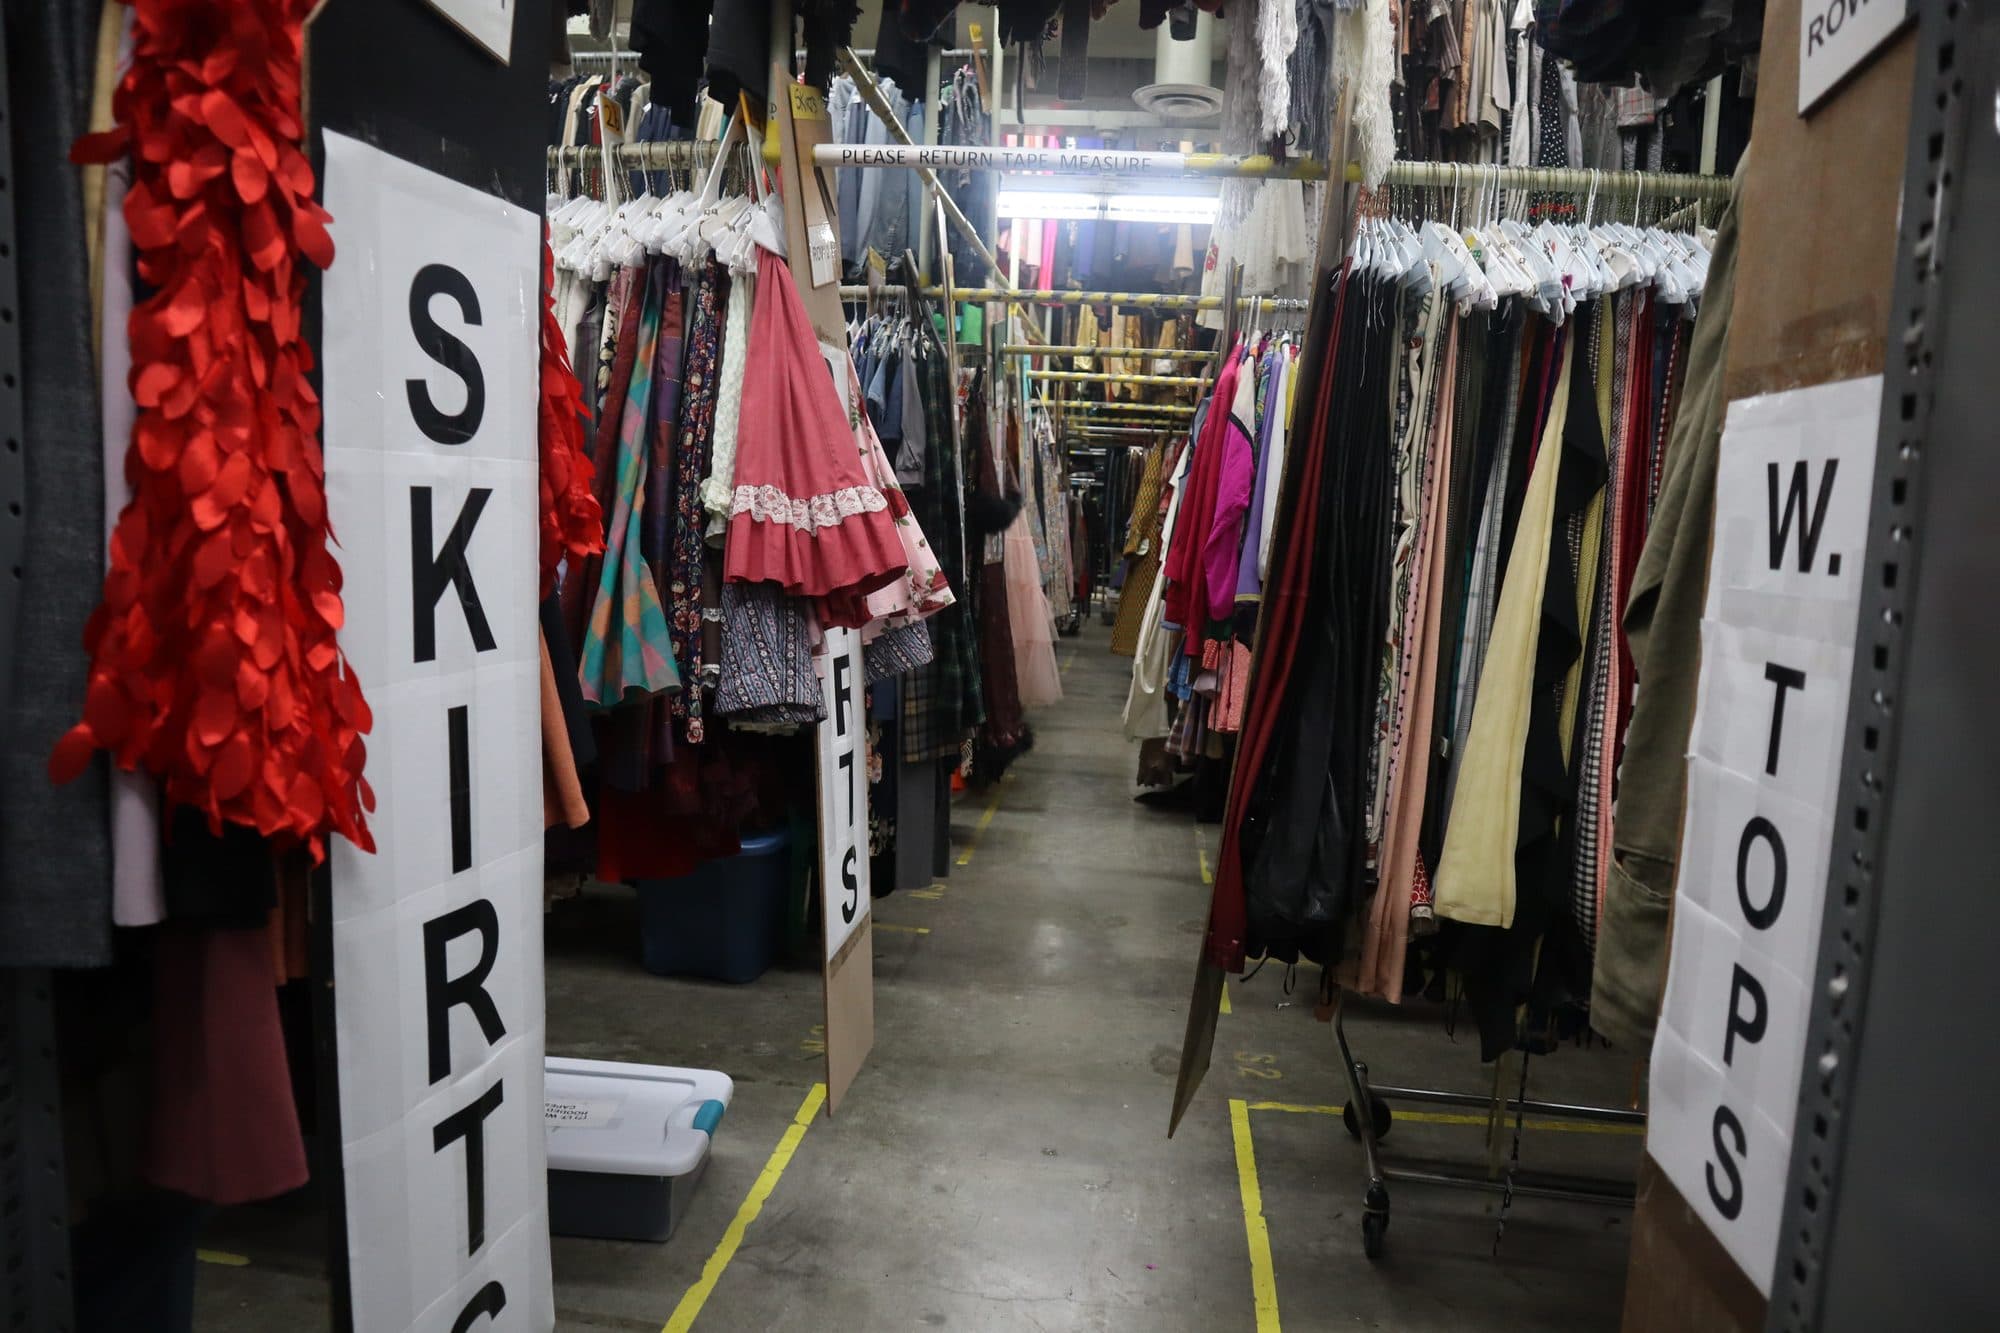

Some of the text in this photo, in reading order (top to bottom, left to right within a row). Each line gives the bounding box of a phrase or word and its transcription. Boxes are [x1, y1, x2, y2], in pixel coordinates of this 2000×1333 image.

[842, 149, 1151, 172] PLEASE RETURN TAPE MEASURE
[1705, 661, 1806, 1222] TOPS
